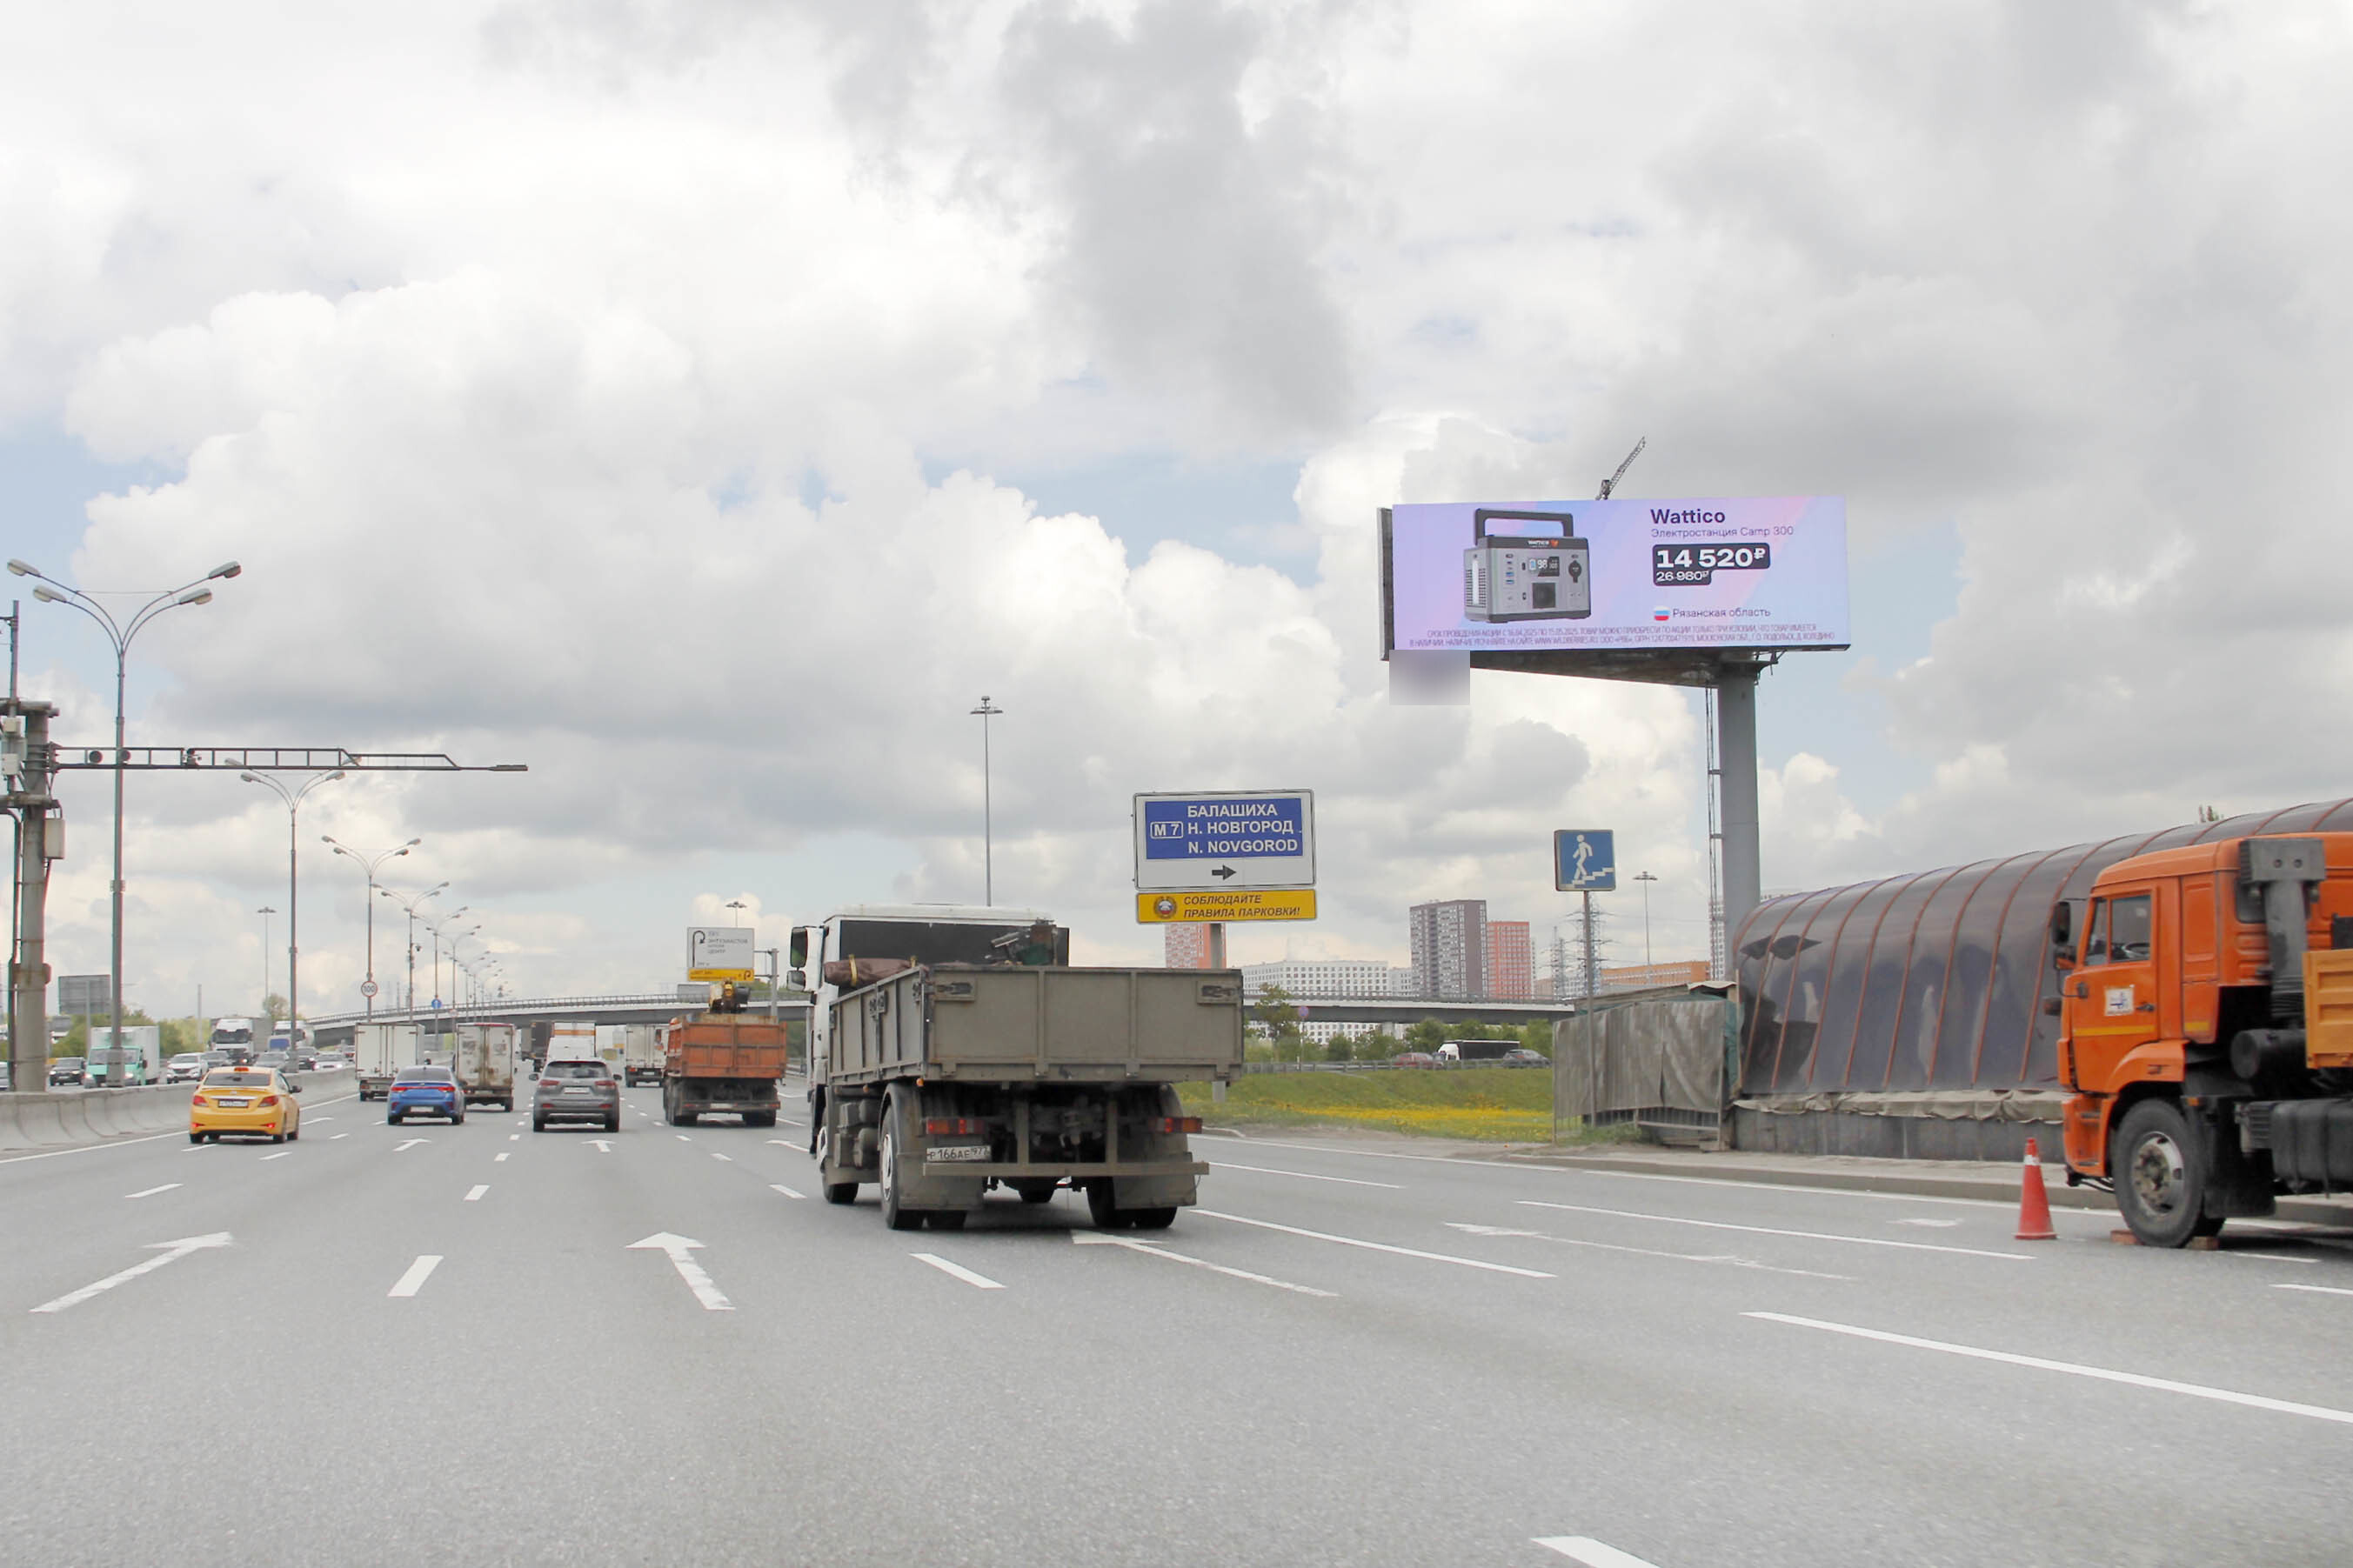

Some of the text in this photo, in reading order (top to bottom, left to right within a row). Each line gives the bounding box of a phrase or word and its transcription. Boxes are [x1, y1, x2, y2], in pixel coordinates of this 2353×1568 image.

[1650, 509, 1726, 524] Wattico
[1651, 525, 1795, 538] Электростанция Camp 300
[1656, 549, 1693, 568] 14
[1656, 571, 1675, 582] 26
[1672, 607, 1772, 618] Рязанская область
[1187, 804, 1278, 818] БАЛАШИХА
[1187, 820, 1293, 835] Н. НОВГОРОД
[1188, 839, 1298, 853] N. NOVGOROD
[1183, 894, 1262, 906] СОБЛЮДАЙТЕ
[1183, 907, 1300, 918] ПРАВИЛА ПАРКОВКИ!
